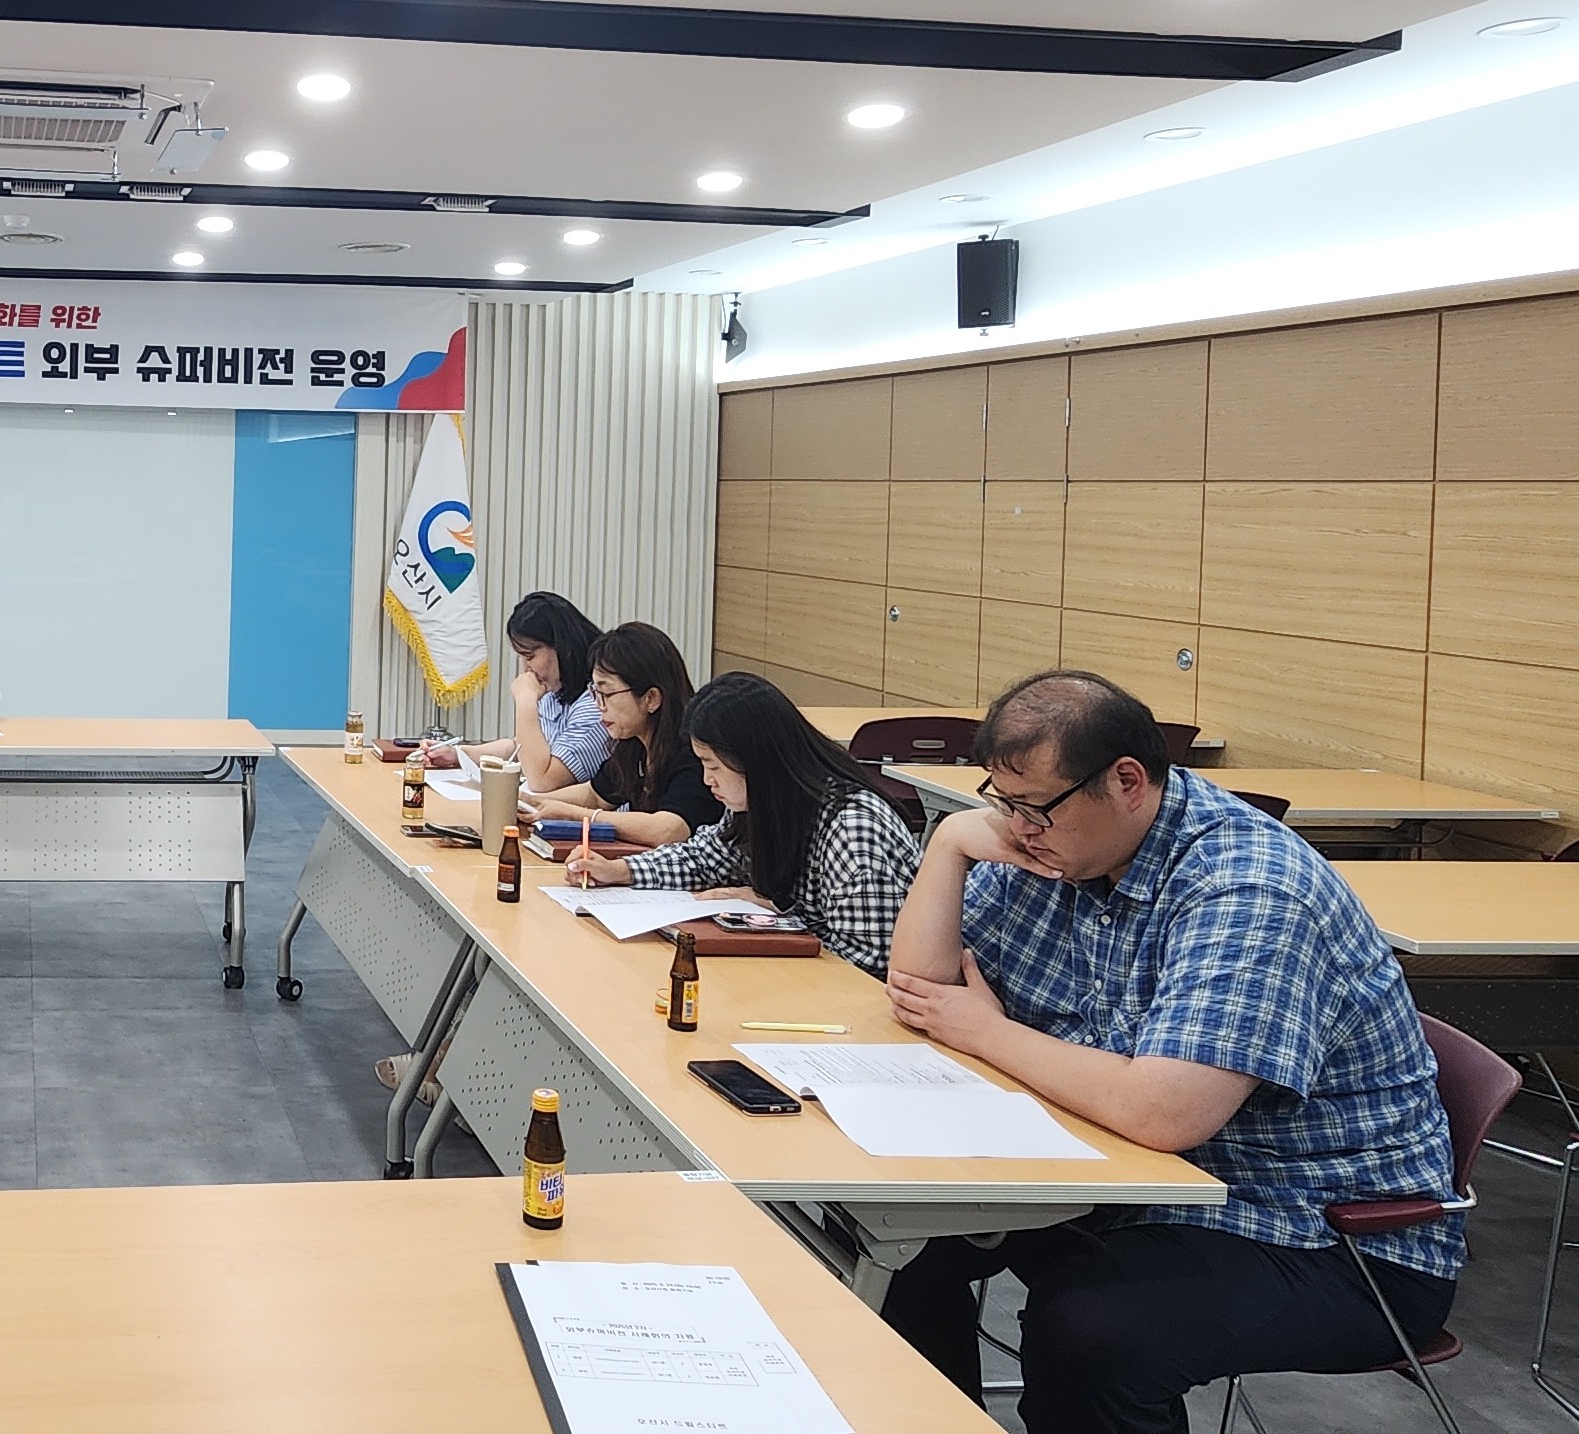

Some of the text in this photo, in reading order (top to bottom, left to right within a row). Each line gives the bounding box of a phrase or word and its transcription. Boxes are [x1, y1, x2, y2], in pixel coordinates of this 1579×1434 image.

[50, 304, 102, 330] 위한
[41, 340, 120, 382] 외부
[136, 344, 295, 386] 슈퍼비전
[310, 349, 387, 388] 운영
[393, 538, 442, 611] 오산시
